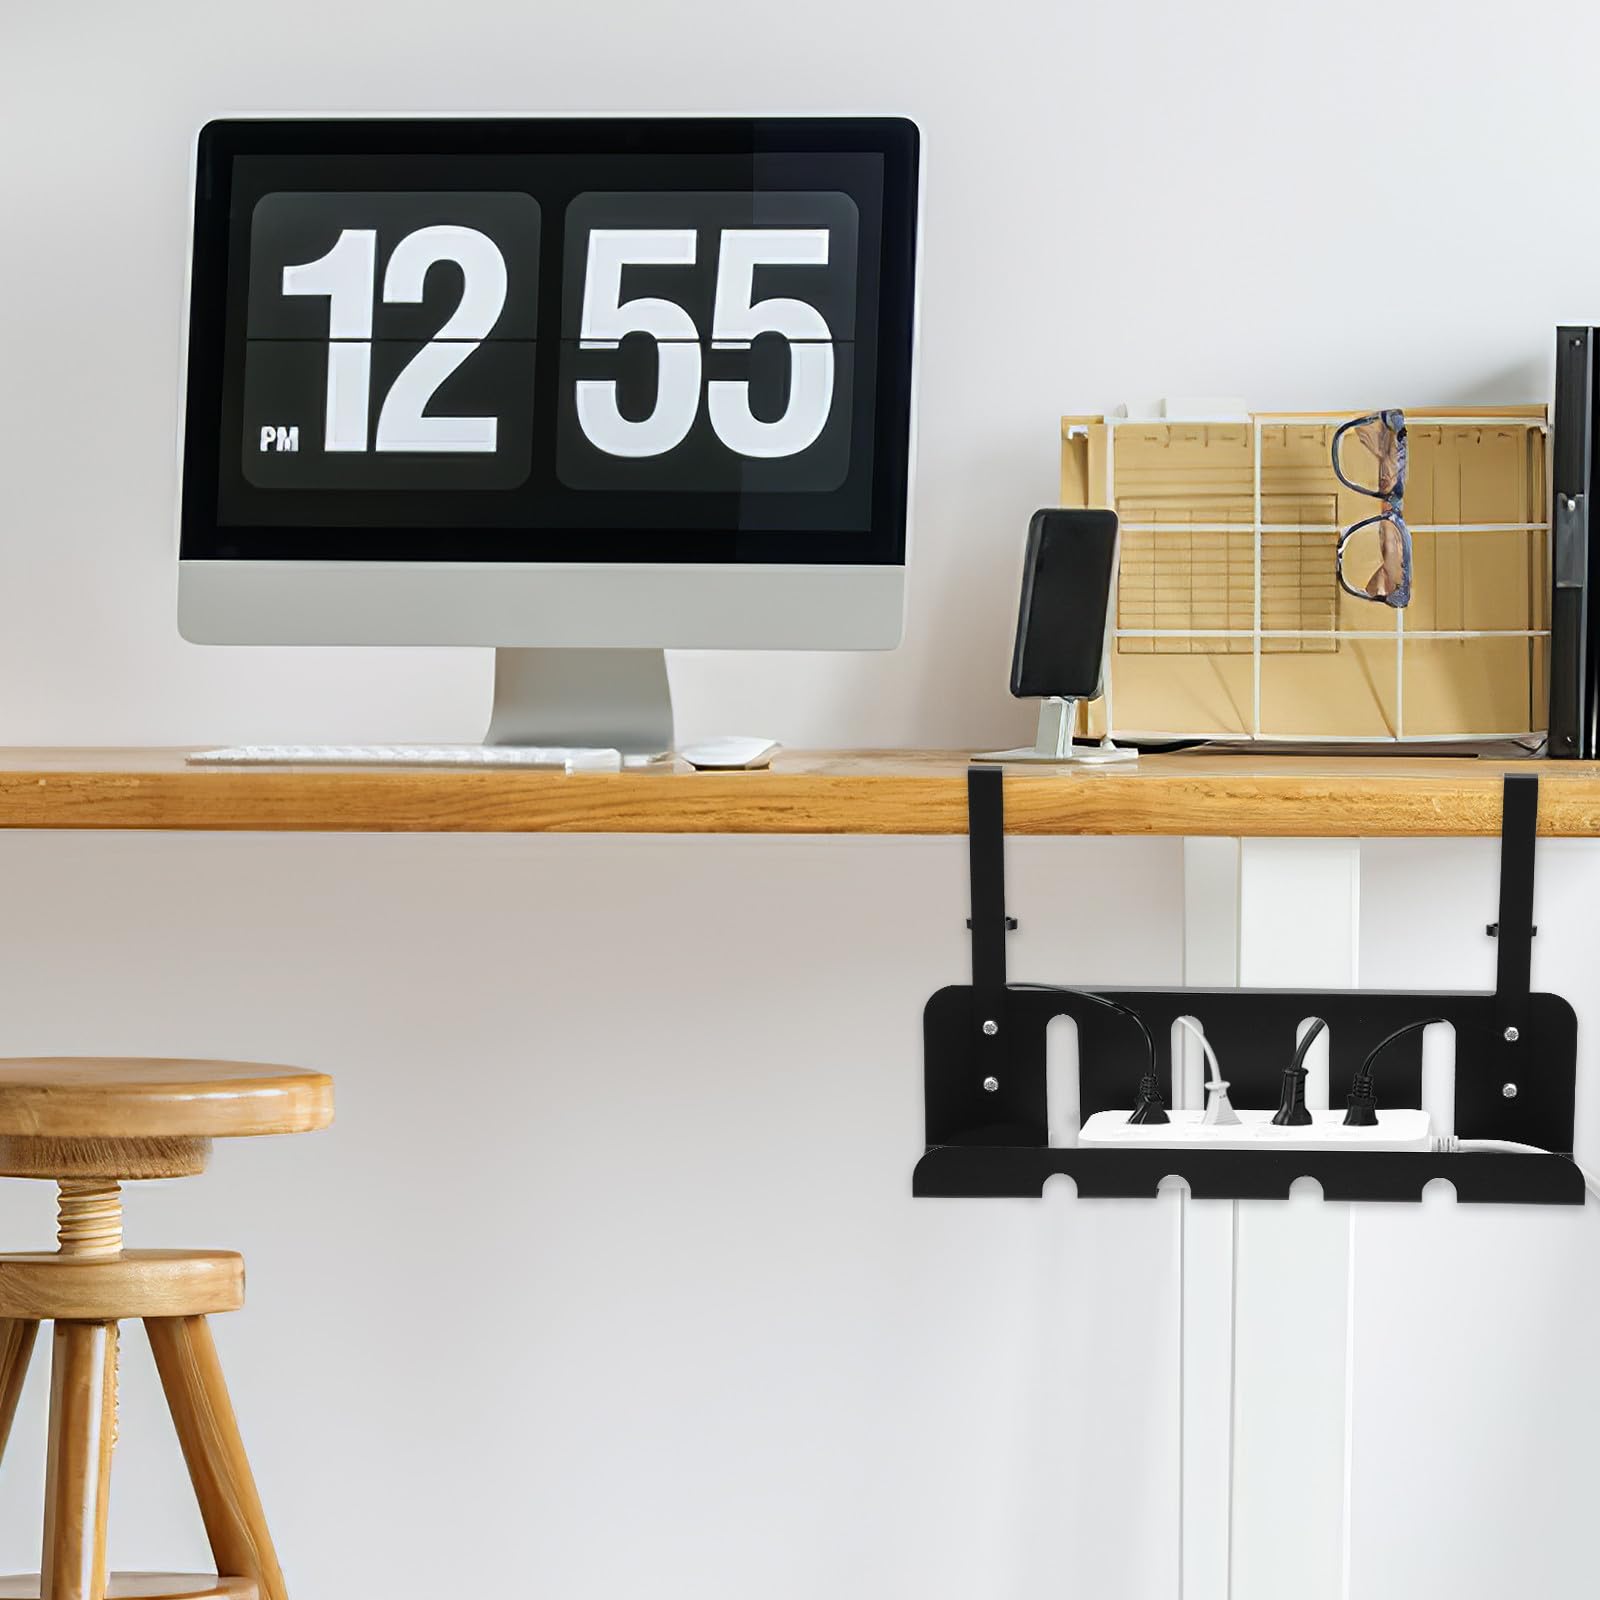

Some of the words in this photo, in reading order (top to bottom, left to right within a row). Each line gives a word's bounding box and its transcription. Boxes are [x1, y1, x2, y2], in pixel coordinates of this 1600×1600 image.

[281, 225, 508, 453] 12
[575, 228, 835, 458] 55
[260, 426, 299, 452] PM
